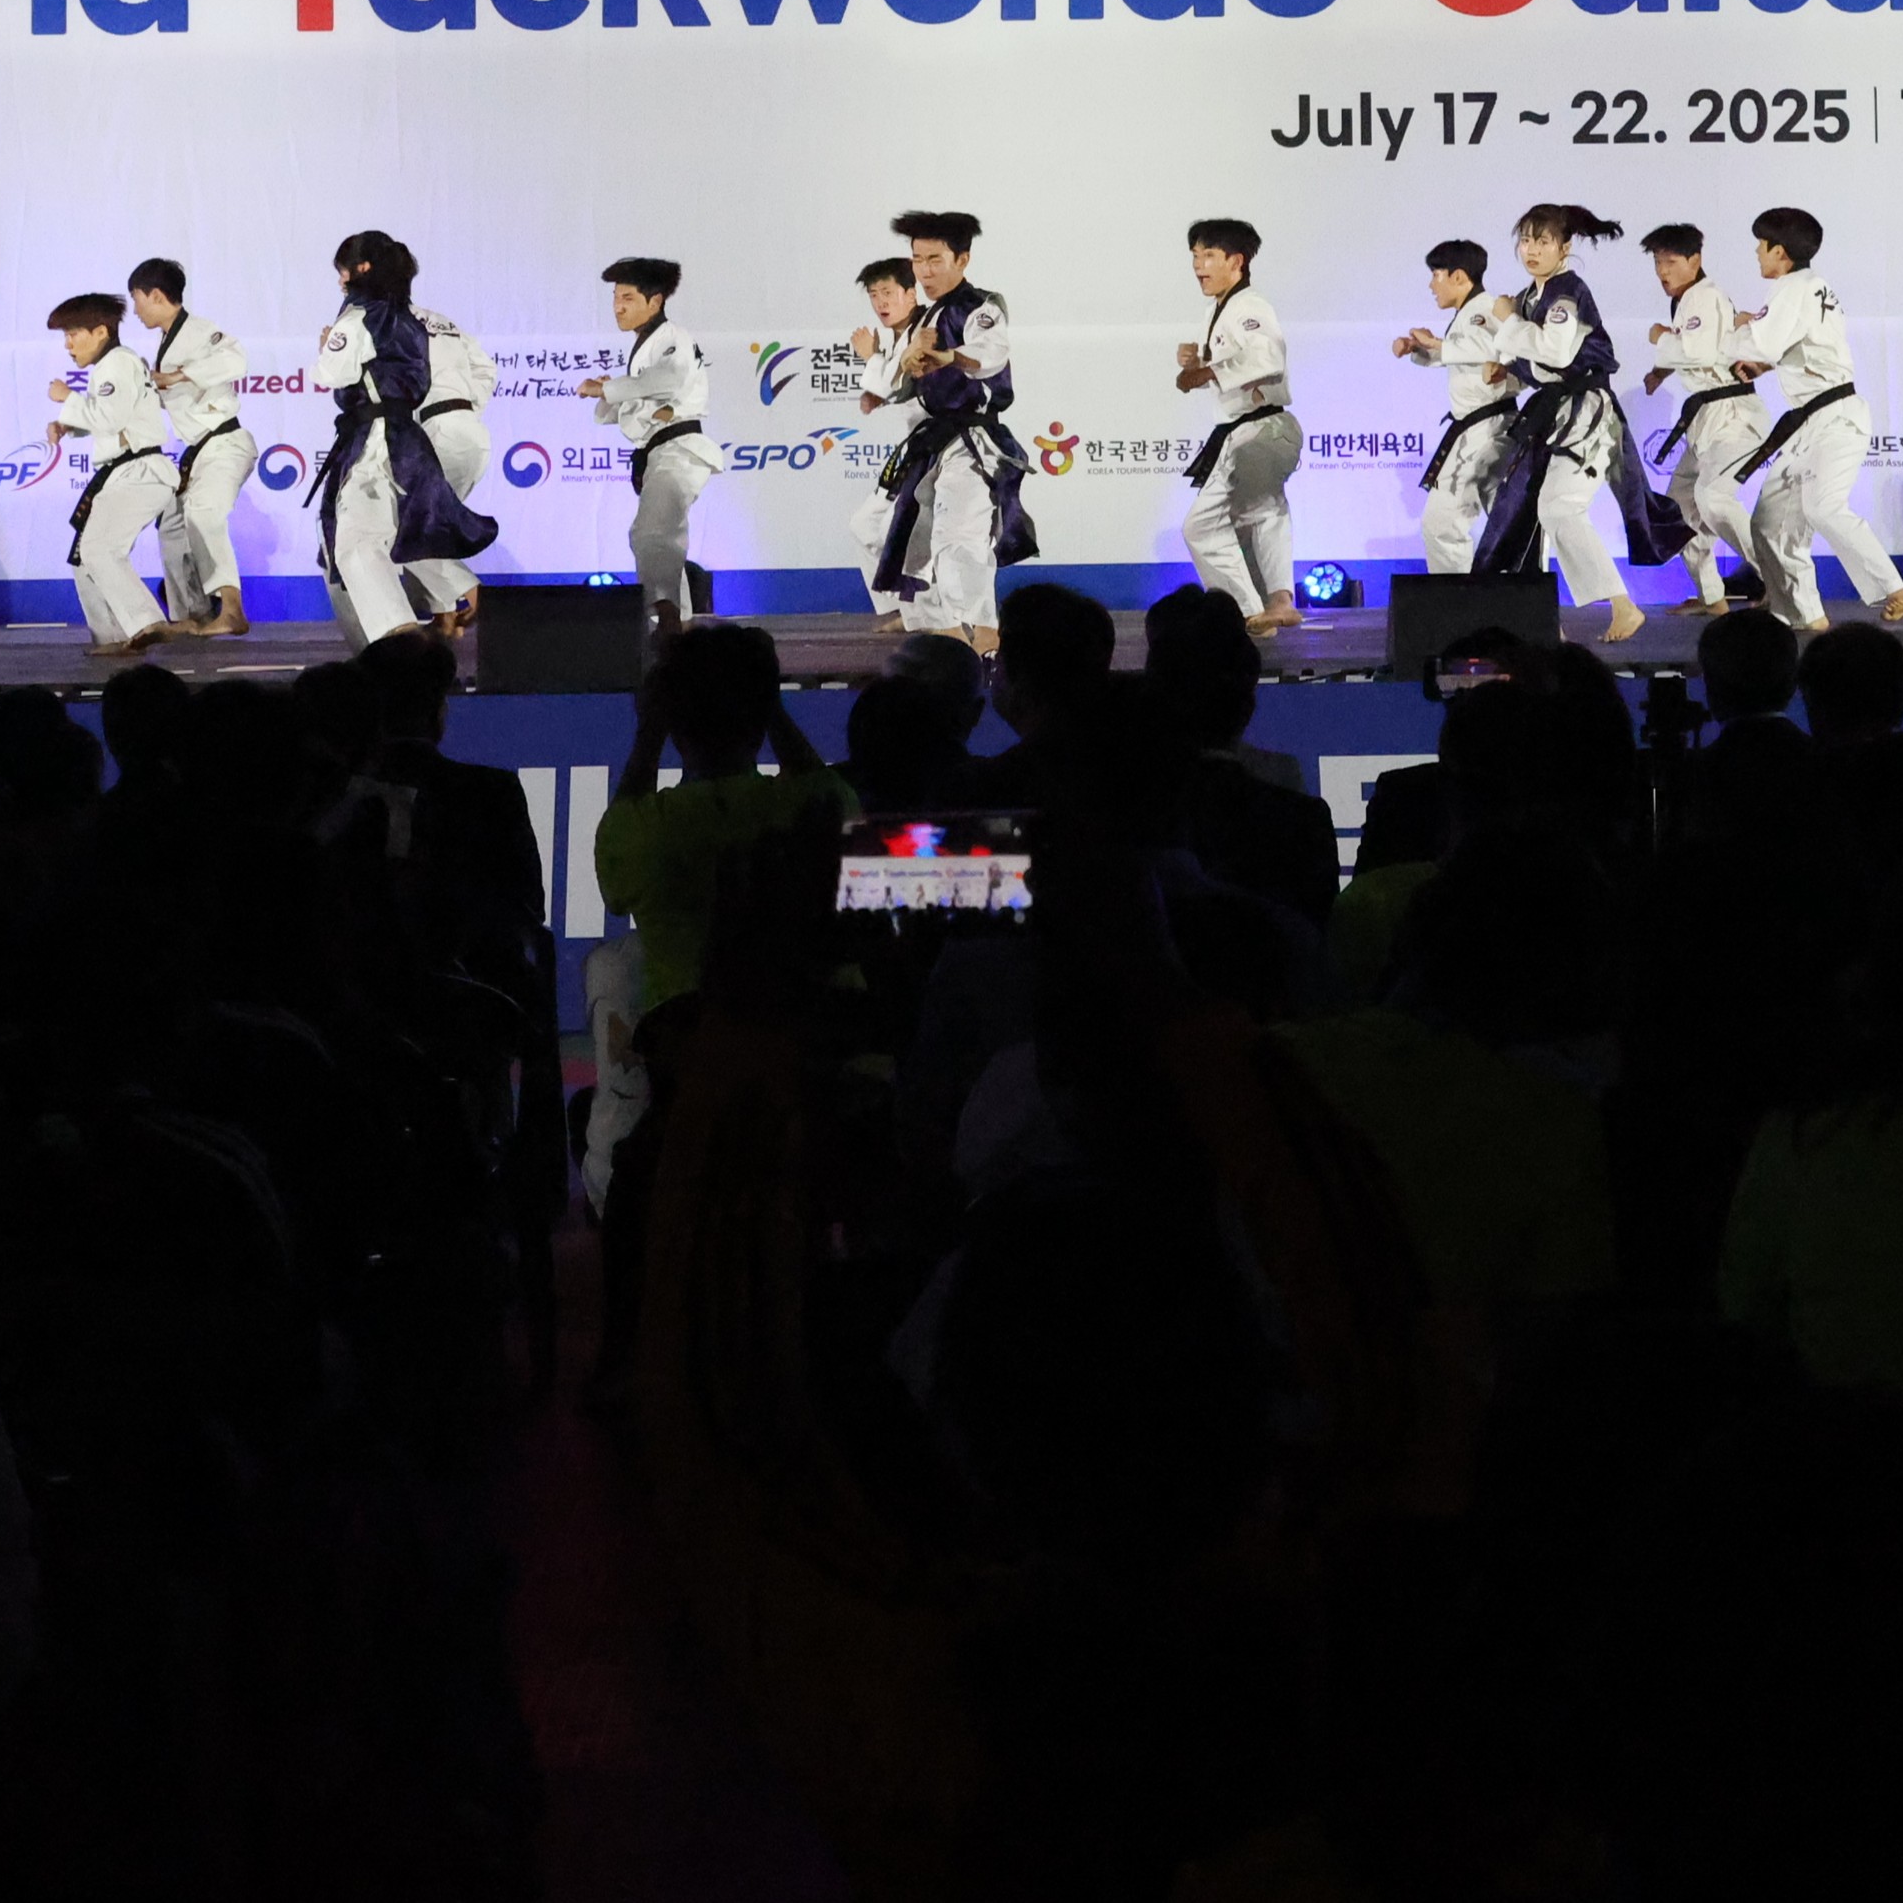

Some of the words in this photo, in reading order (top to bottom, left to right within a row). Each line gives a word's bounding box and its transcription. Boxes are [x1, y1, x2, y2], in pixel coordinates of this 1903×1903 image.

[1271, 92, 1414, 161] July
[1433, 92, 1497, 145] 17
[1570, 89, 1668, 145] 22.
[1687, 88, 1850, 144] 2025
[1309, 432, 1424, 458] 대한체육회
[1087, 467, 1113, 476] KOREA
[1116, 466, 1151, 475] TOURISM
[1309, 461, 1339, 470] Korean
[1342, 461, 1375, 472] Olympic
[1377, 461, 1423, 470] Committee
[561, 474, 592, 484] Ministry
[844, 469, 870, 480] Korea
